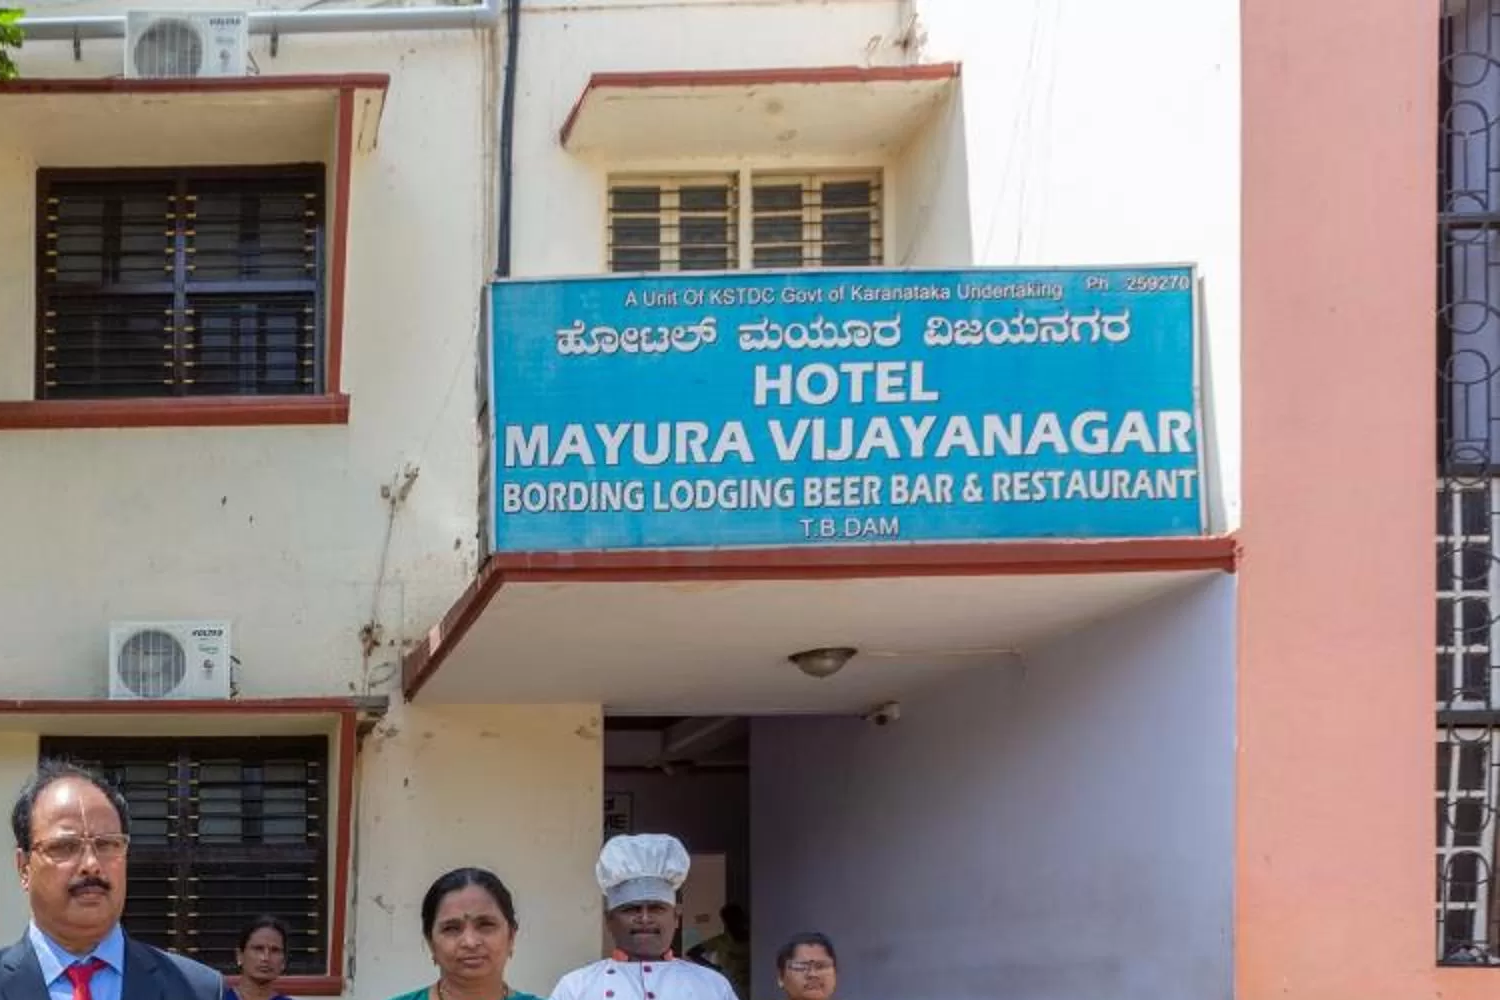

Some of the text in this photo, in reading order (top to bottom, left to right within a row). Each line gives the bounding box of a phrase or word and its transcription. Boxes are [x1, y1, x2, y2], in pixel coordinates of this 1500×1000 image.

[624, 282, 1063, 308] A Unit Of KSTDC Govt of Karanataka Undertaking
[739, 314, 901, 350] ಮಯೂರ
[925, 308, 1130, 346] ವಿಜಯನಗರ
[755, 361, 939, 405] HOTEL
[505, 411, 1193, 466] MAYURA VIJAYANAGAR
[502, 468, 1198, 514] BORDING LODGING BEER BAR & RESTAURANT
